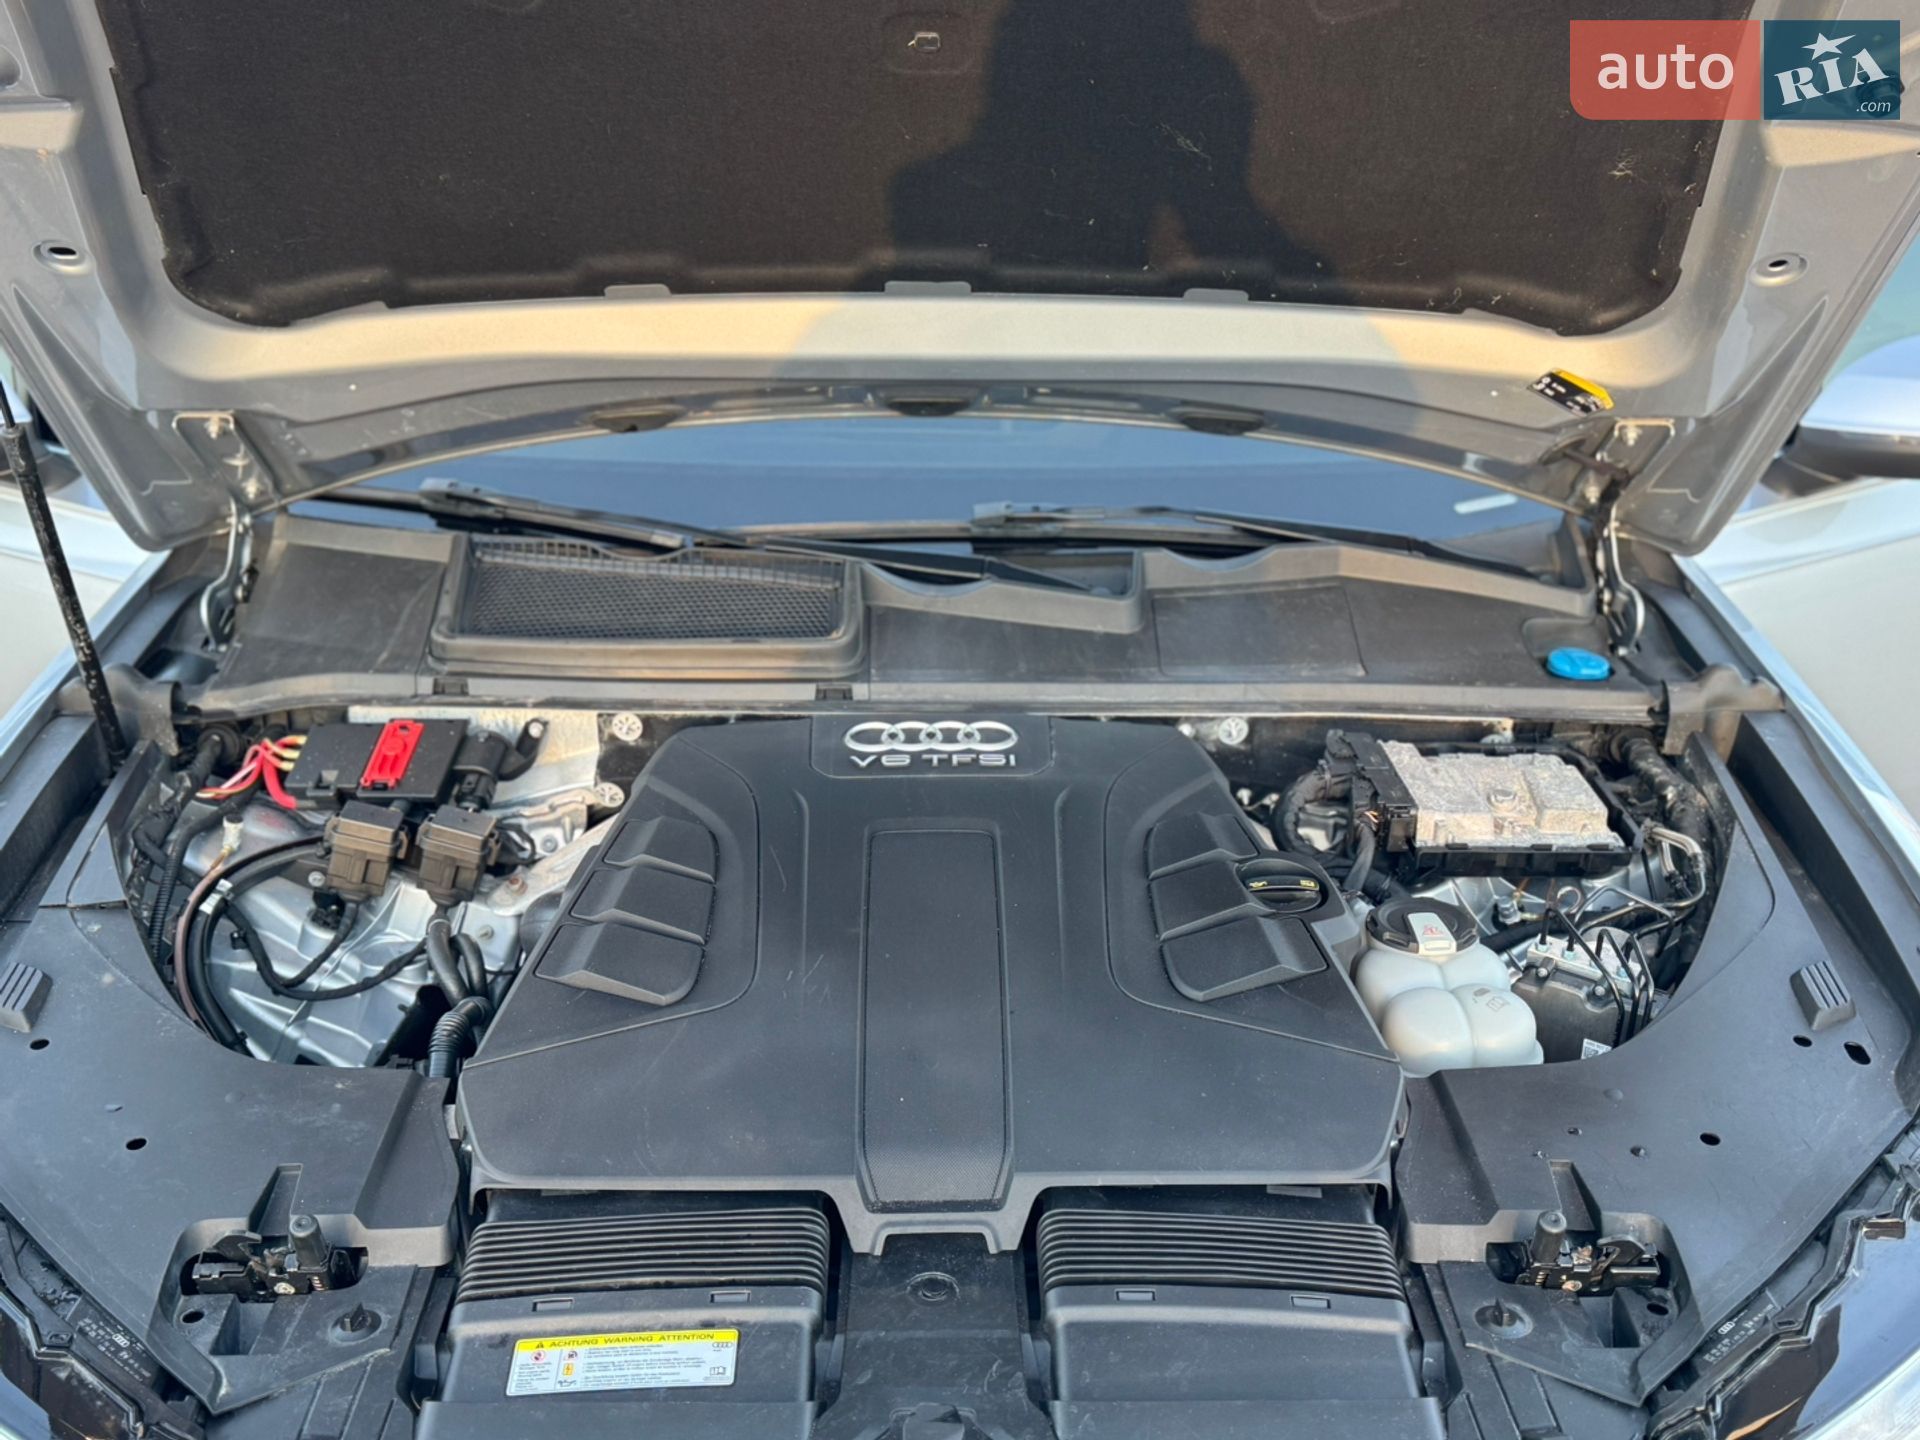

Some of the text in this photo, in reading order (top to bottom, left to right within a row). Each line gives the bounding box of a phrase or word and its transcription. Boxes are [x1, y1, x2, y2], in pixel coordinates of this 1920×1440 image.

[850, 754, 1017, 768] V6 TFSI
[549, 1333, 715, 1347] ACHTUNG WARNING ATTENTION
